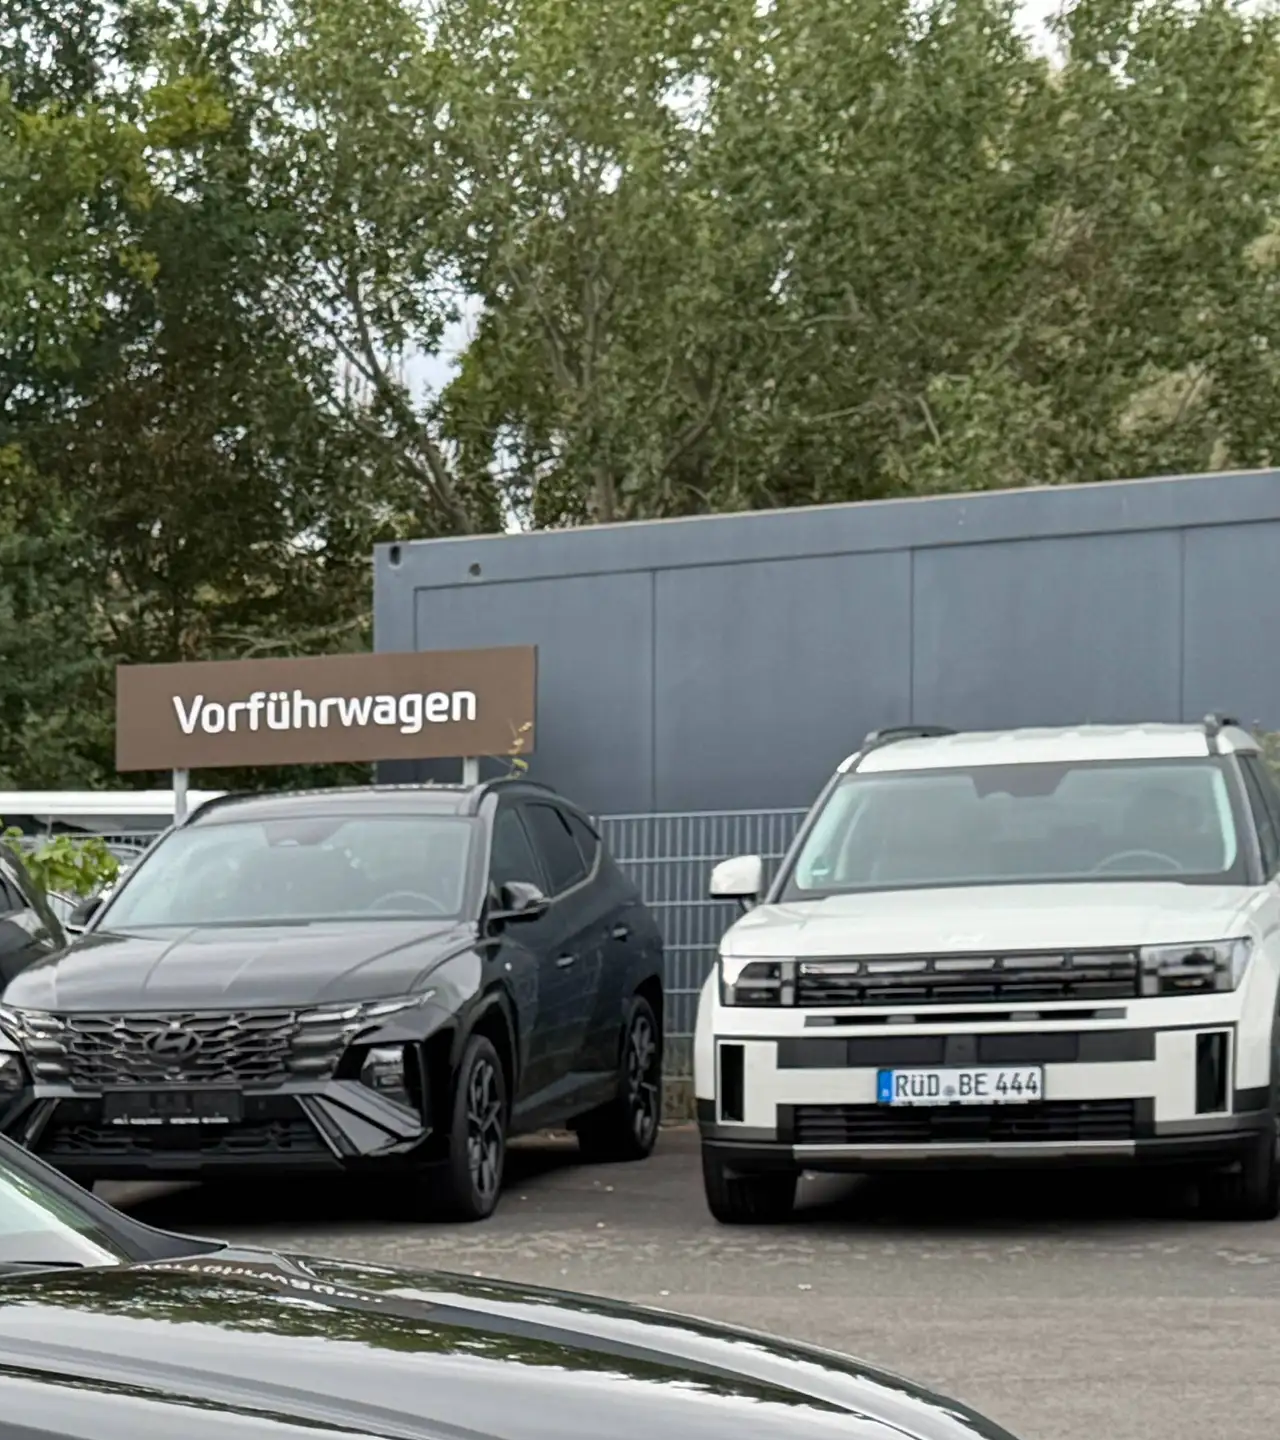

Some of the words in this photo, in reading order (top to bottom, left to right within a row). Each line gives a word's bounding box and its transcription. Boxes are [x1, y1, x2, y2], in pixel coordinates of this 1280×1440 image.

[172, 689, 477, 734] Vorführwagen
[895, 1073, 940, 1097] RÜD
[958, 1073, 989, 1096] BE
[995, 1071, 1038, 1095] 444
